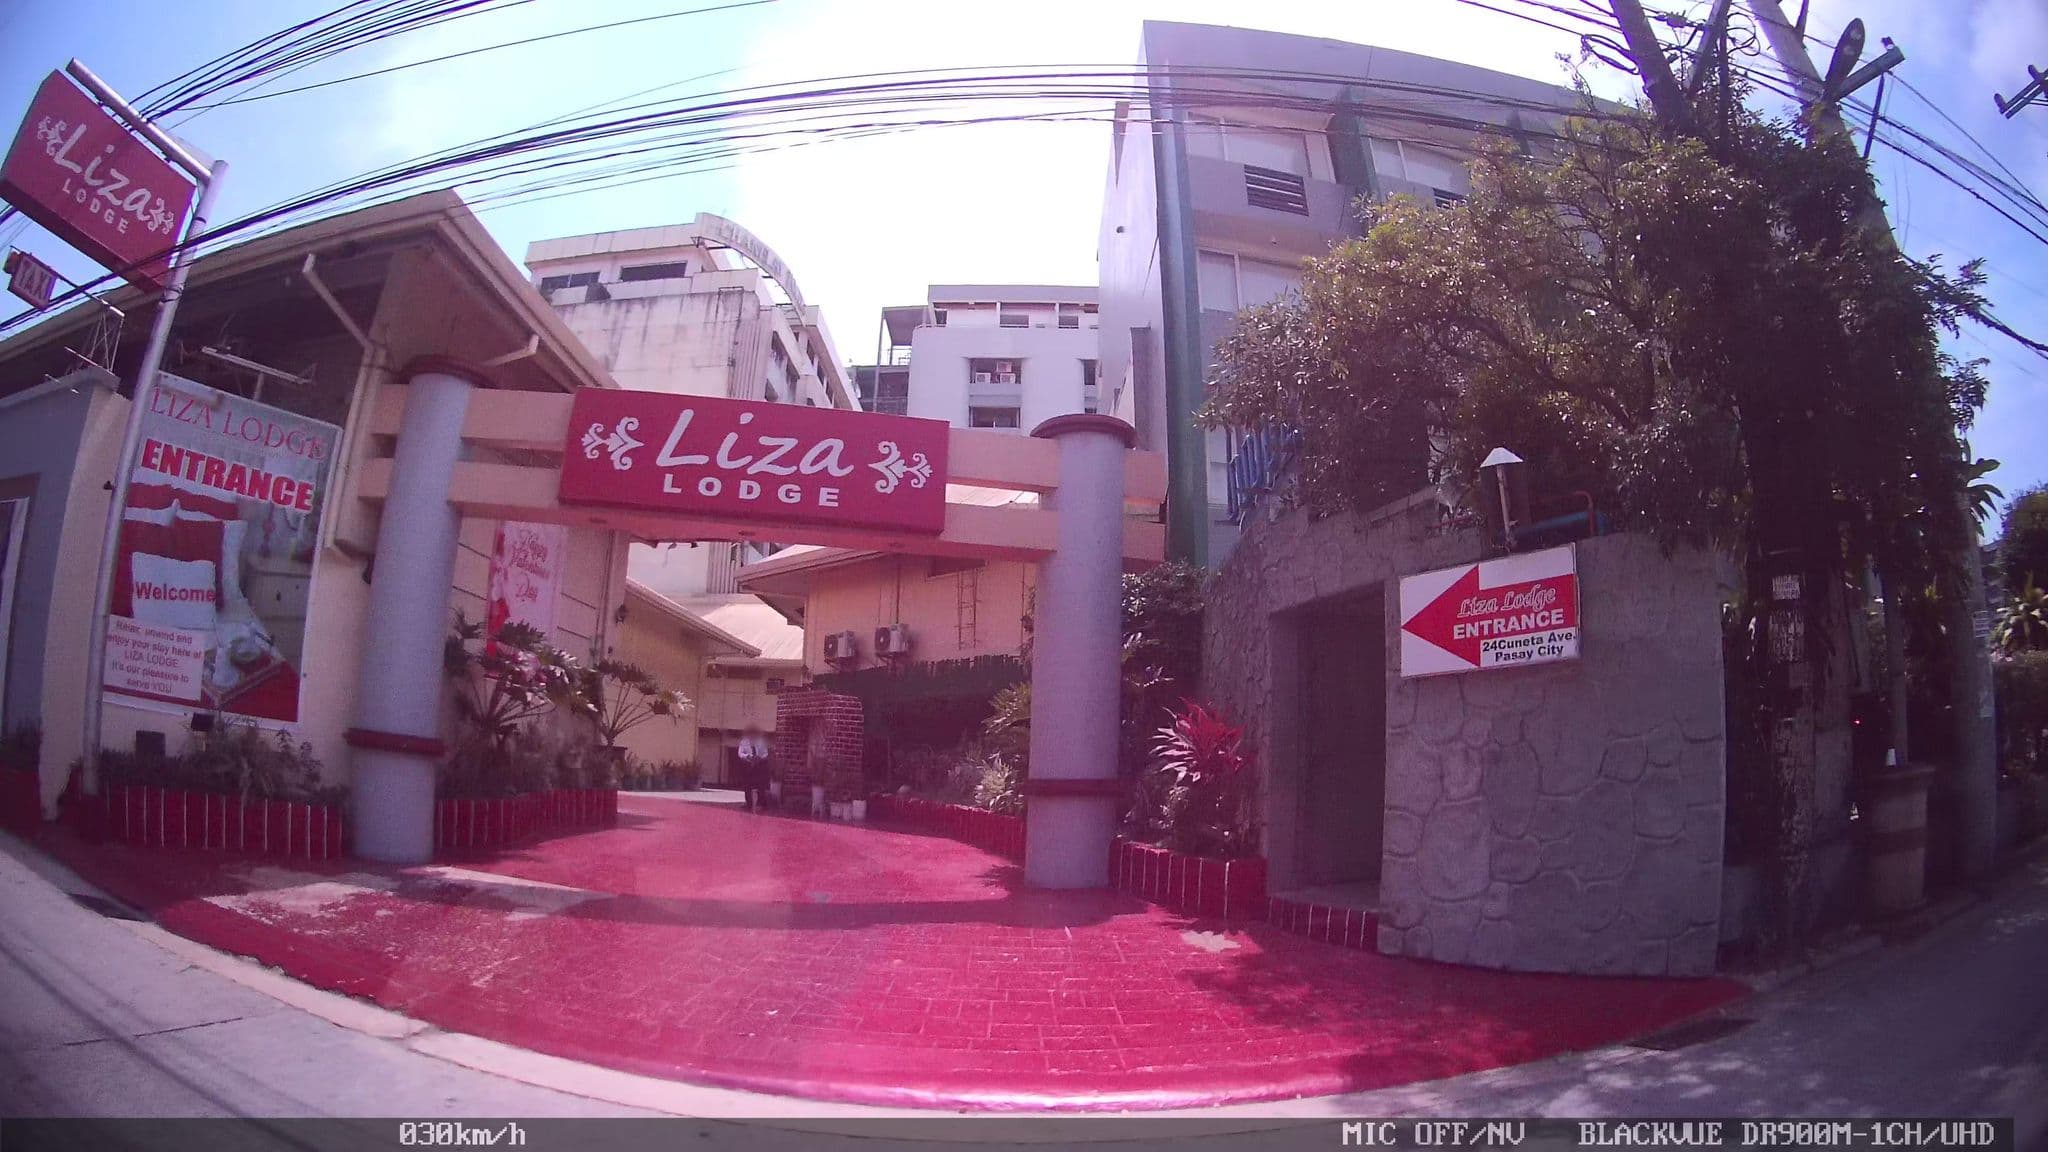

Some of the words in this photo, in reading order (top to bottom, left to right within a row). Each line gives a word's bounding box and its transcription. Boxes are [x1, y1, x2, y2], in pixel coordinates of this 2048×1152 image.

[53, 123, 152, 222] Liza
[62, 178, 129, 234] LODGE
[151, 386, 212, 428] LIZA
[223, 410, 327, 461] LODGE
[655, 408, 854, 478] Liza
[141, 438, 315, 512] ENTRANCE
[663, 473, 840, 507] LODGE
[135, 582, 217, 601] Welcome
[1457, 596, 1498, 618] Liza
[1501, 584, 1556, 609] Lodge
[1453, 609, 1564, 640] ENTRANCE
[1482, 635, 1544, 652] 24Cuneta
[1548, 631, 1577, 644] Ave.
[124, 651, 144, 662] LIZA
[147, 652, 179, 668] LODGE
[131, 639, 151, 651] your
[1495, 650, 1533, 662] Pasay
[1537, 644, 1564, 657] City
